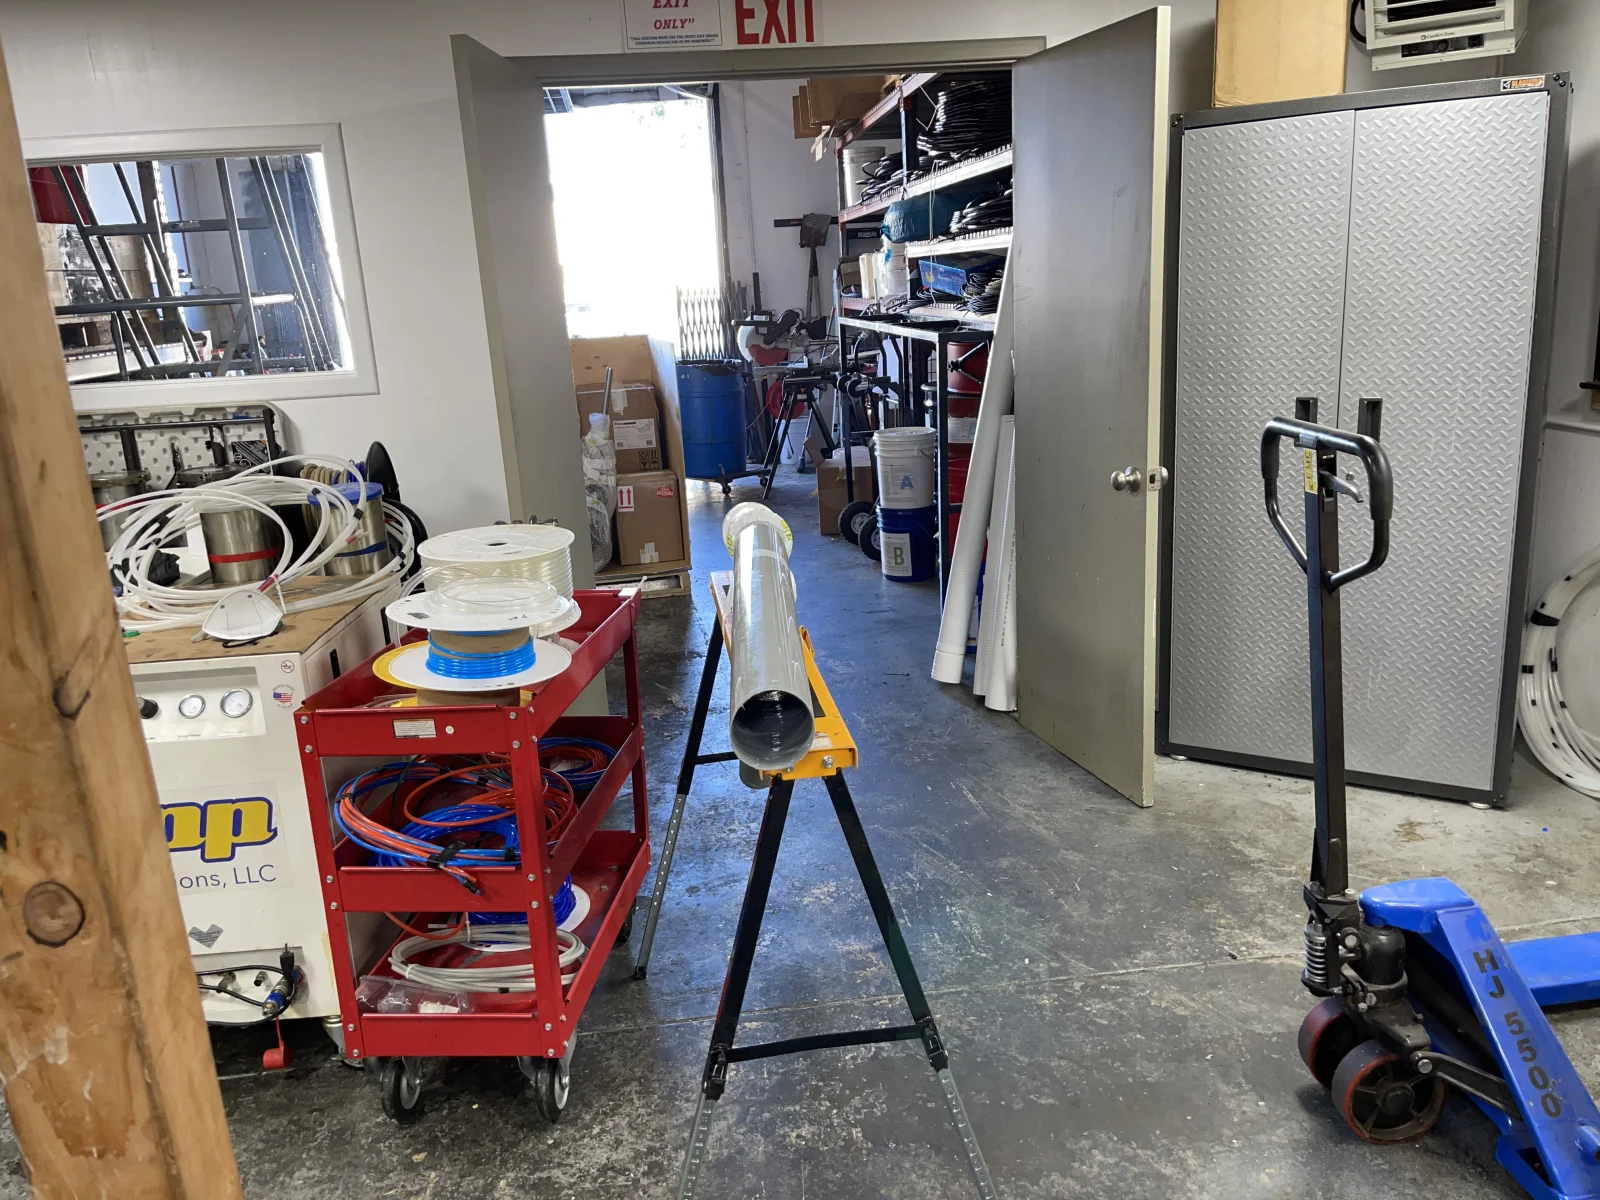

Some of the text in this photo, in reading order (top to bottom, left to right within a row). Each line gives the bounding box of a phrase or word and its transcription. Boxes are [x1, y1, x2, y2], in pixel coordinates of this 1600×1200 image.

[652, 0, 690, 9] EXIT
[735, 0, 815, 45] EXIT
[900, 475, 915, 489] A
[893, 546, 905, 566] B
[233, 864, 277, 885] LLC
[1472, 948, 1562, 1119] HJ 5500
